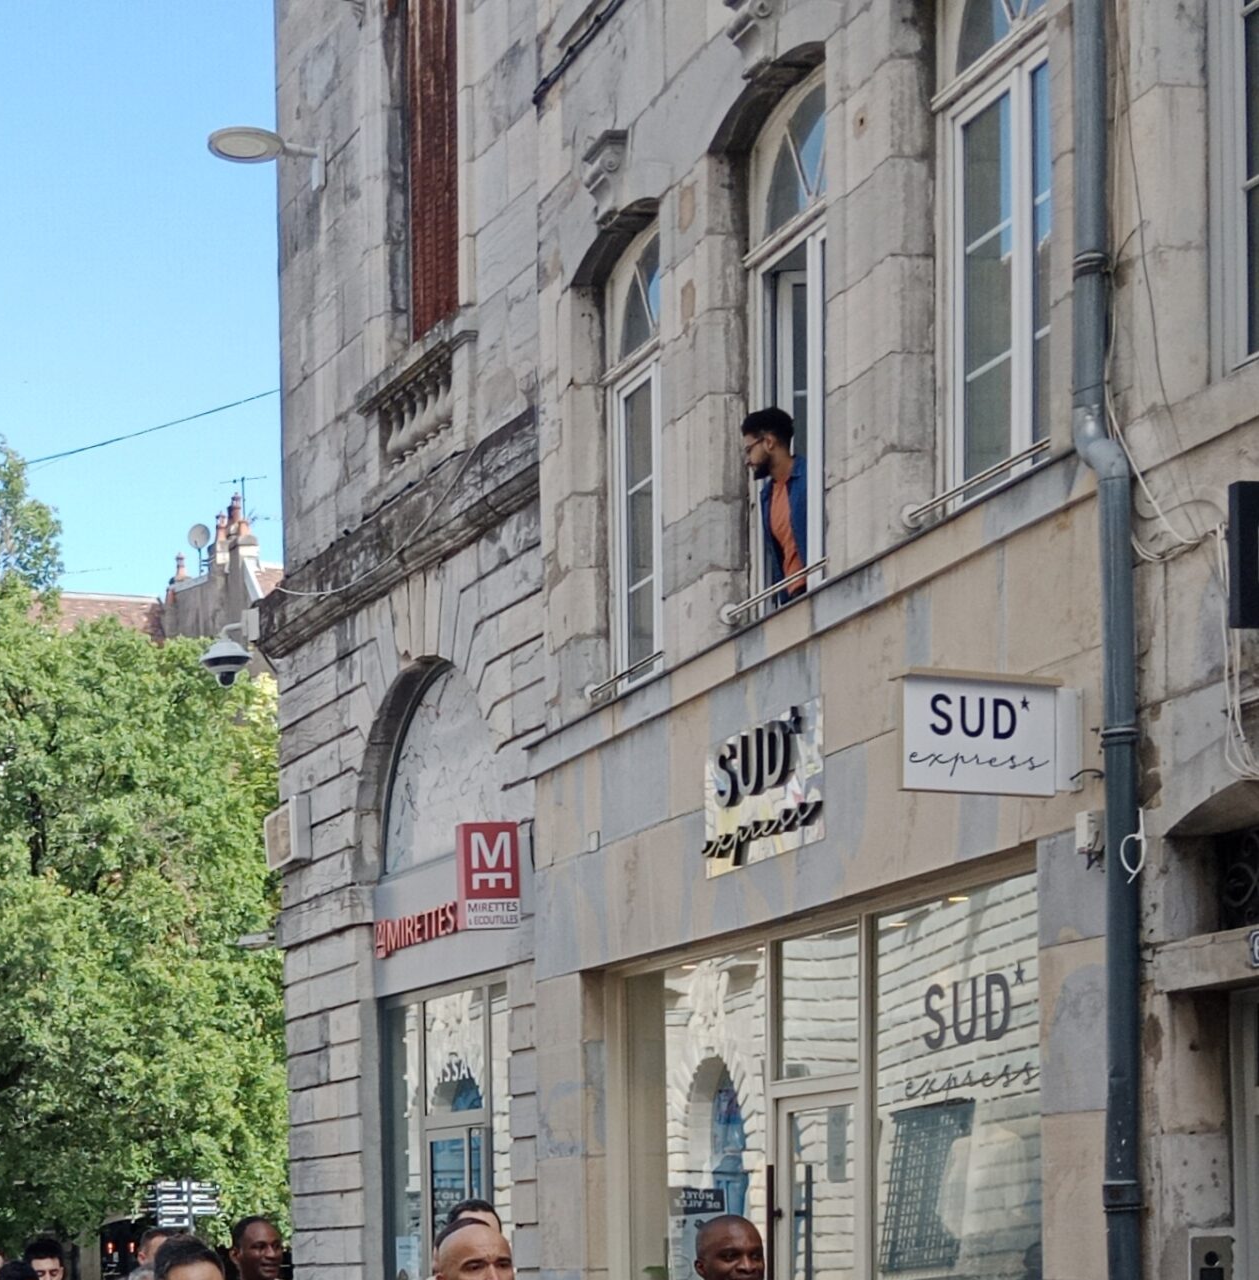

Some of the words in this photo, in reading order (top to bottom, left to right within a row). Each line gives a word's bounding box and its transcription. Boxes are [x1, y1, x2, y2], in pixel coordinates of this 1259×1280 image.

[930, 693, 1017, 740] SUD
[714, 720, 791, 808] SUD
[908, 751, 1050, 777] express
[702, 800, 823, 866] express
[387, 901, 456, 952] MIRETTES
[468, 901, 518, 913] MIRETTES
[474, 914, 519, 925] ECOUTILLES
[924, 972, 1011, 1050] SUD
[905, 1061, 1040, 1103] express
